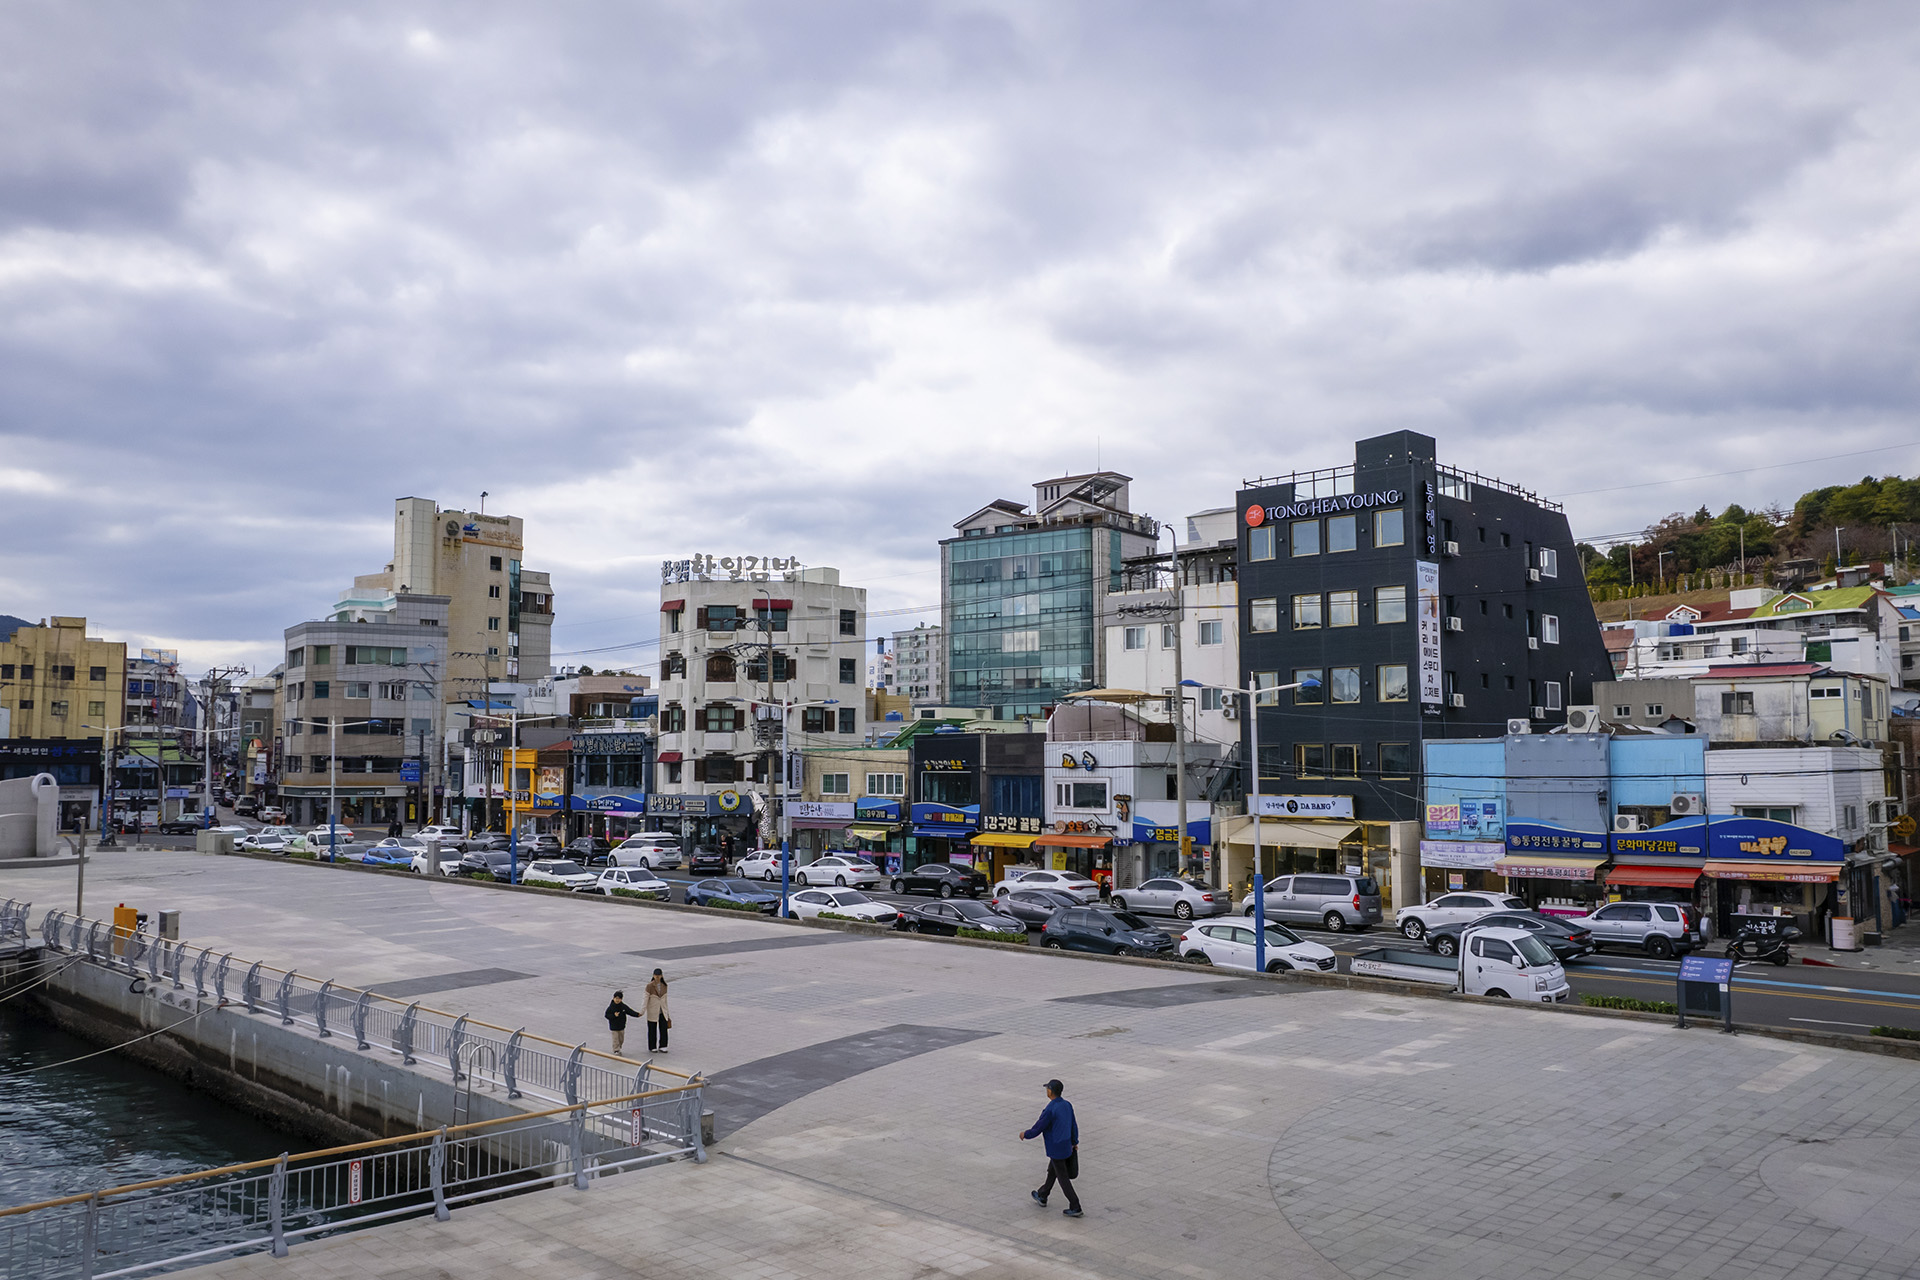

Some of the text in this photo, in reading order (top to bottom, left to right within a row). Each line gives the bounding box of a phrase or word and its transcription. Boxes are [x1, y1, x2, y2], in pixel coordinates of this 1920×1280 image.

[1266, 489, 1400, 520] TONG HEA YOUNG
[691, 553, 800, 583] 한일김밥
[1424, 661, 1439, 671] 스무디
[14, 747, 48, 756] 세무법인
[650, 796, 681, 811] 한일김밥
[989, 816, 1017, 830] 강구안
[1020, 817, 1041, 832] 꿀빵
[1522, 835, 1581, 848] 통영전통꿀빵
[1617, 839, 1677, 852] 문화마당김밥
